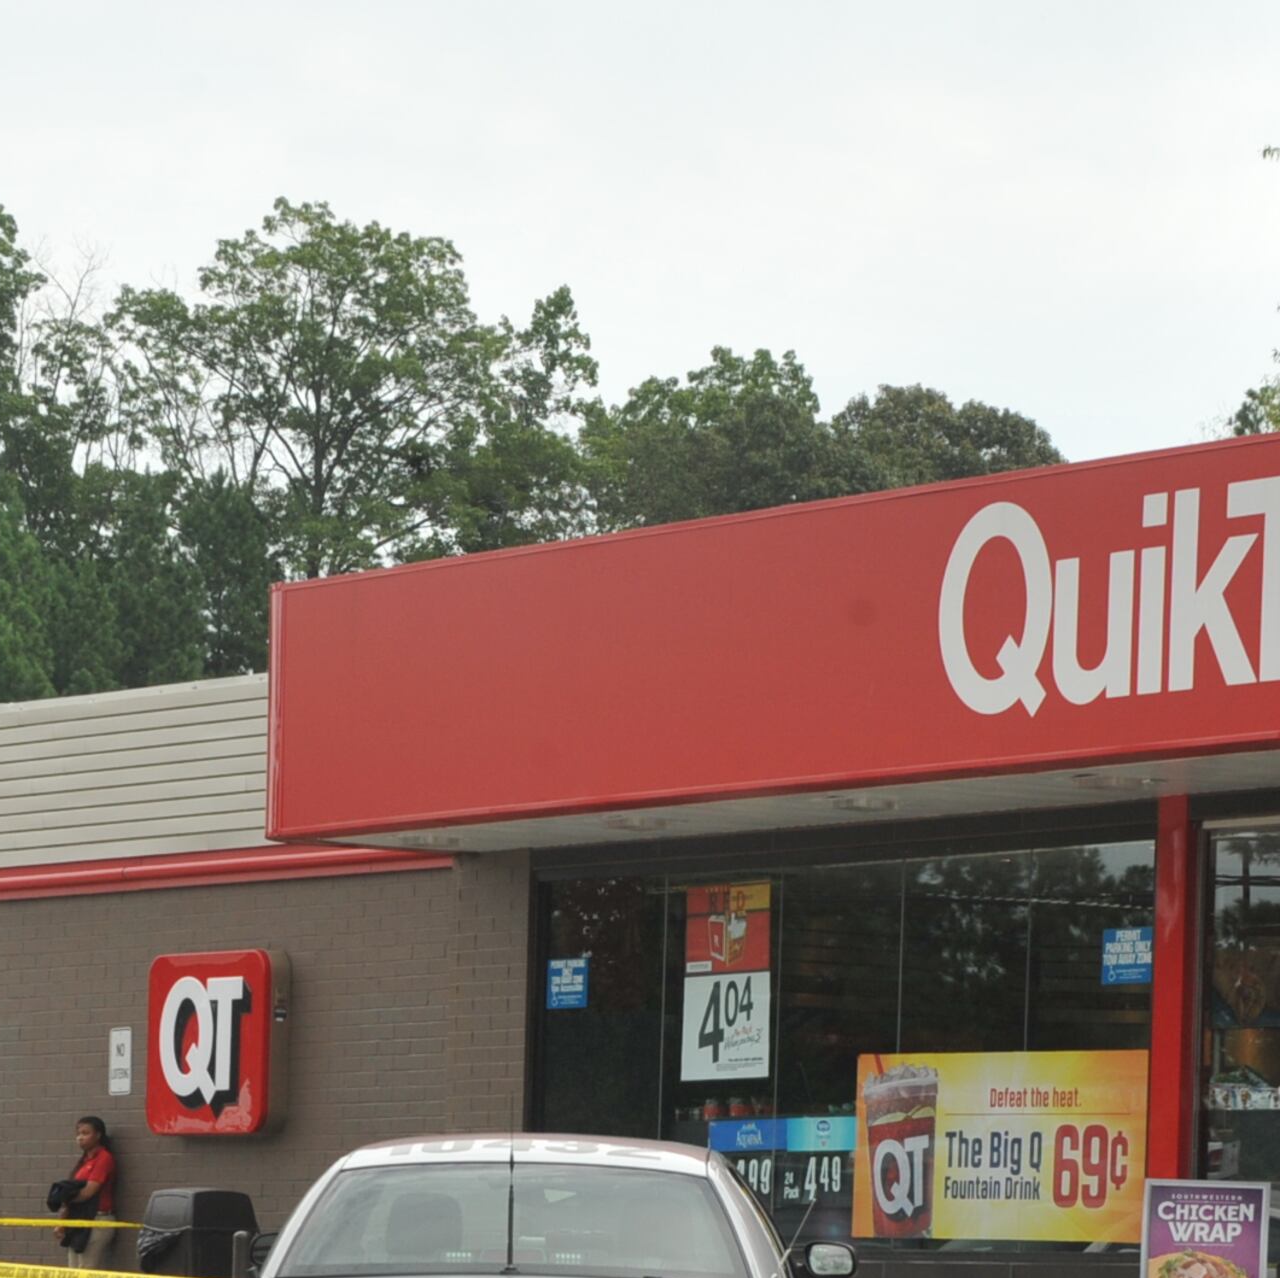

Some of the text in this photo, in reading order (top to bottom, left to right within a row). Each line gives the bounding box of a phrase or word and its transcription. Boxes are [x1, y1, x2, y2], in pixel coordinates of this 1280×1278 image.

[115, 1043, 126, 1057] NO
[159, 976, 244, 1105] QT
[990, 1087, 1082, 1108] Defeat the heat.
[945, 1130, 1043, 1176] The Big Q
[873, 1134, 929, 1217] QT
[784, 1186, 800, 1200] Pack
[944, 1176, 1041, 1200] Fountain Drink
[1157, 1201, 1254, 1222] CHICKEN
[1168, 1222, 1242, 1243] WRAP
